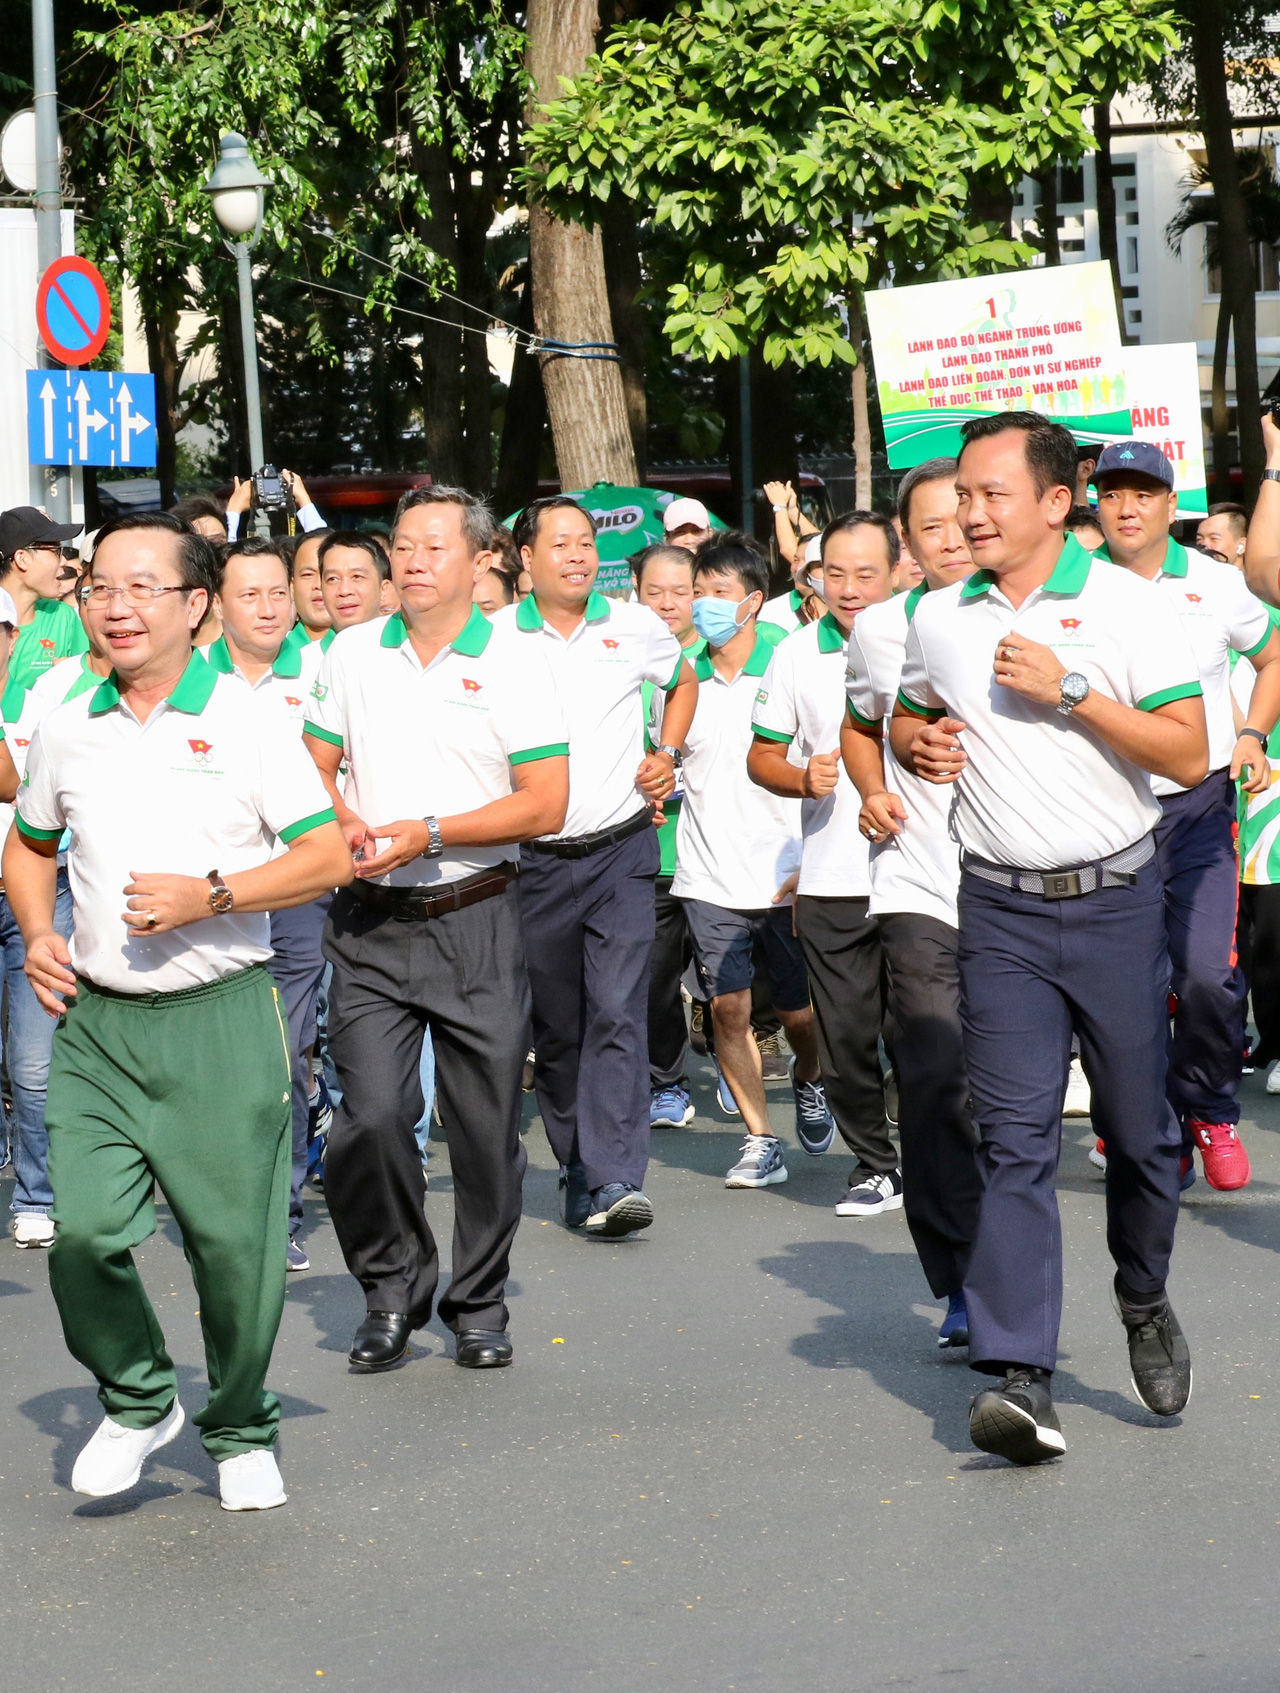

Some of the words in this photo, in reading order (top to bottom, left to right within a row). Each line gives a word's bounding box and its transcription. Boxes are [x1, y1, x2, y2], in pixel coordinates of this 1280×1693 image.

[985, 297, 997, 319] 1
[1015, 324, 1051, 339] TRUNG
[1053, 320, 1082, 335] ƯƠNG
[1009, 364, 1031, 379] ĐƠN
